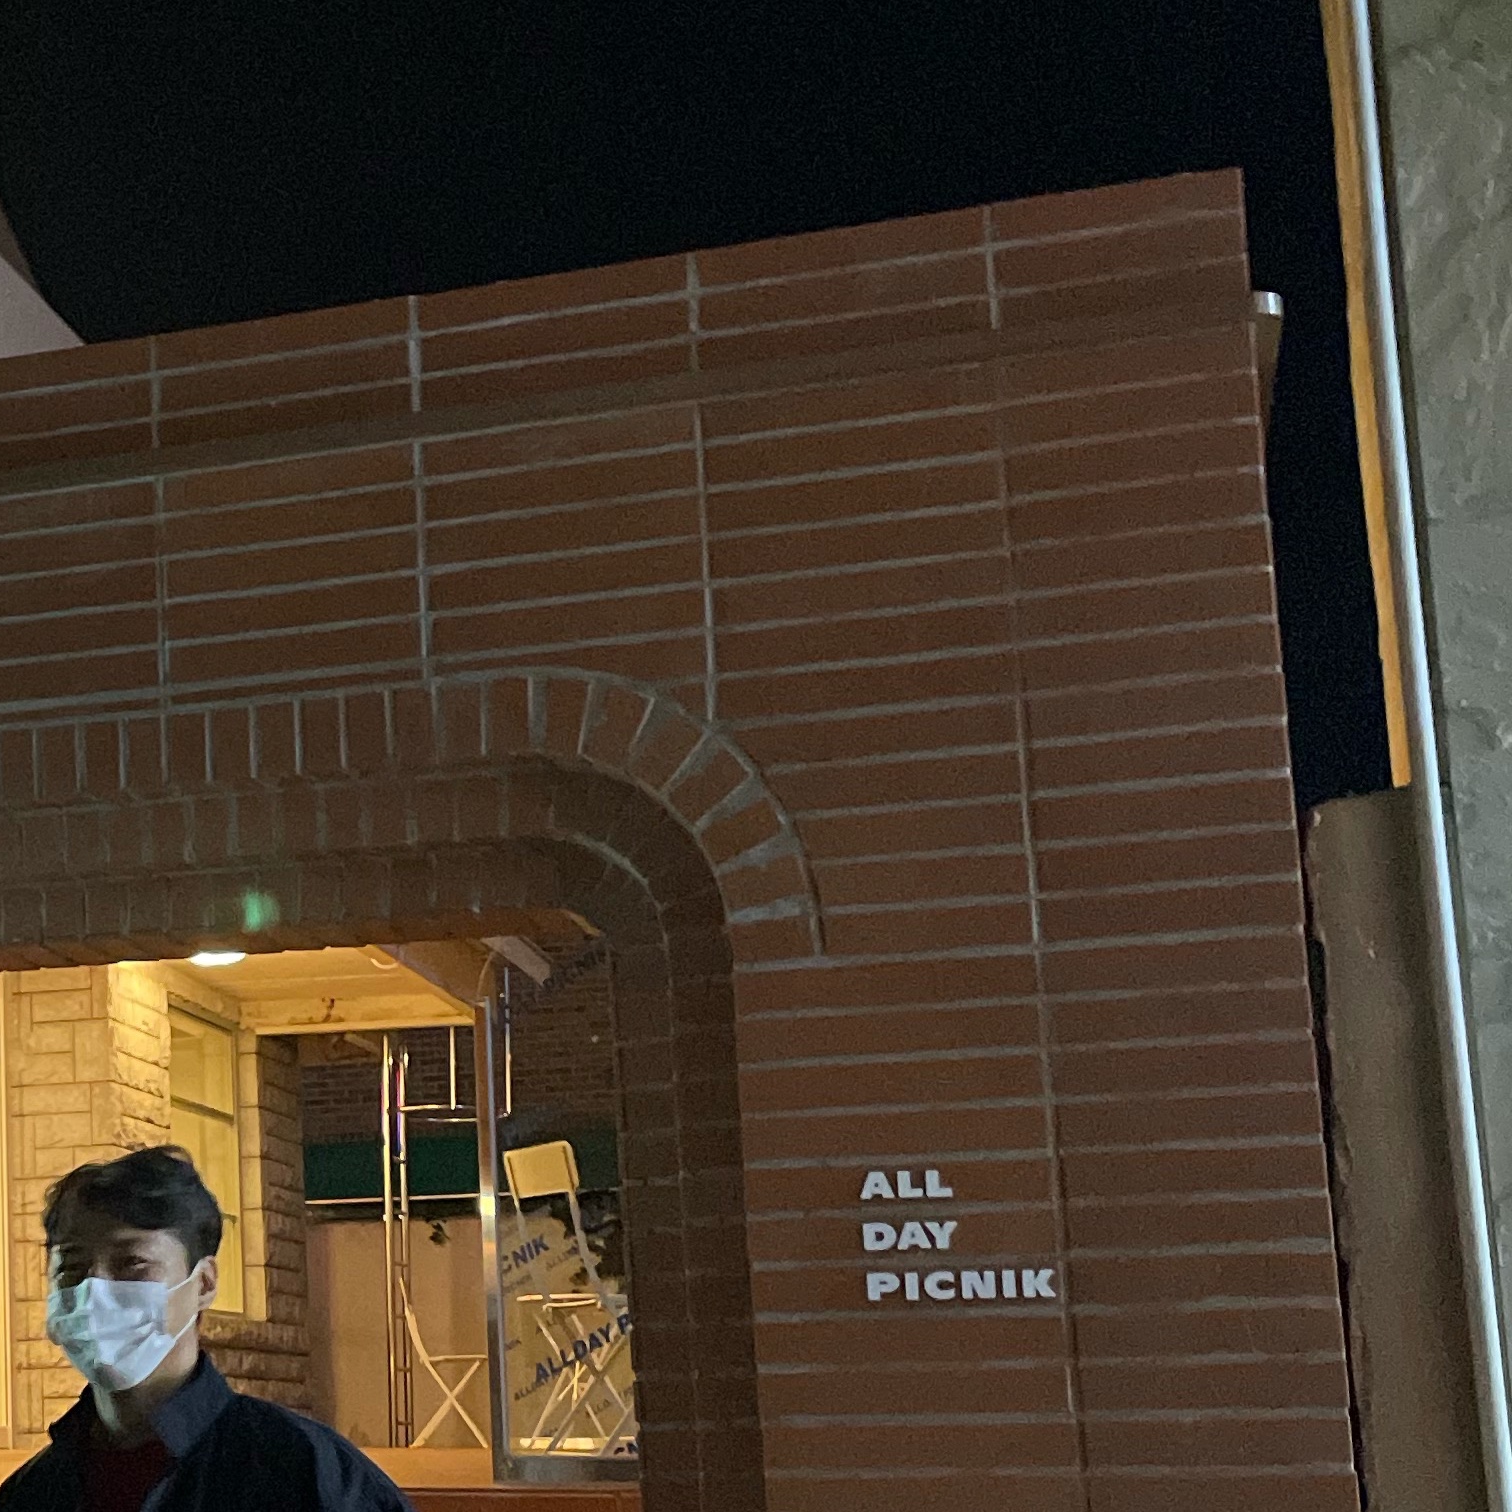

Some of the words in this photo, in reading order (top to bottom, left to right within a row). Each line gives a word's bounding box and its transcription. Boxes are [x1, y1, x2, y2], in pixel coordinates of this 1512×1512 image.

[860, 1169, 954, 1200] ALL
[862, 1220, 958, 1251] DAY
[866, 1268, 1056, 1301] PICNIK
